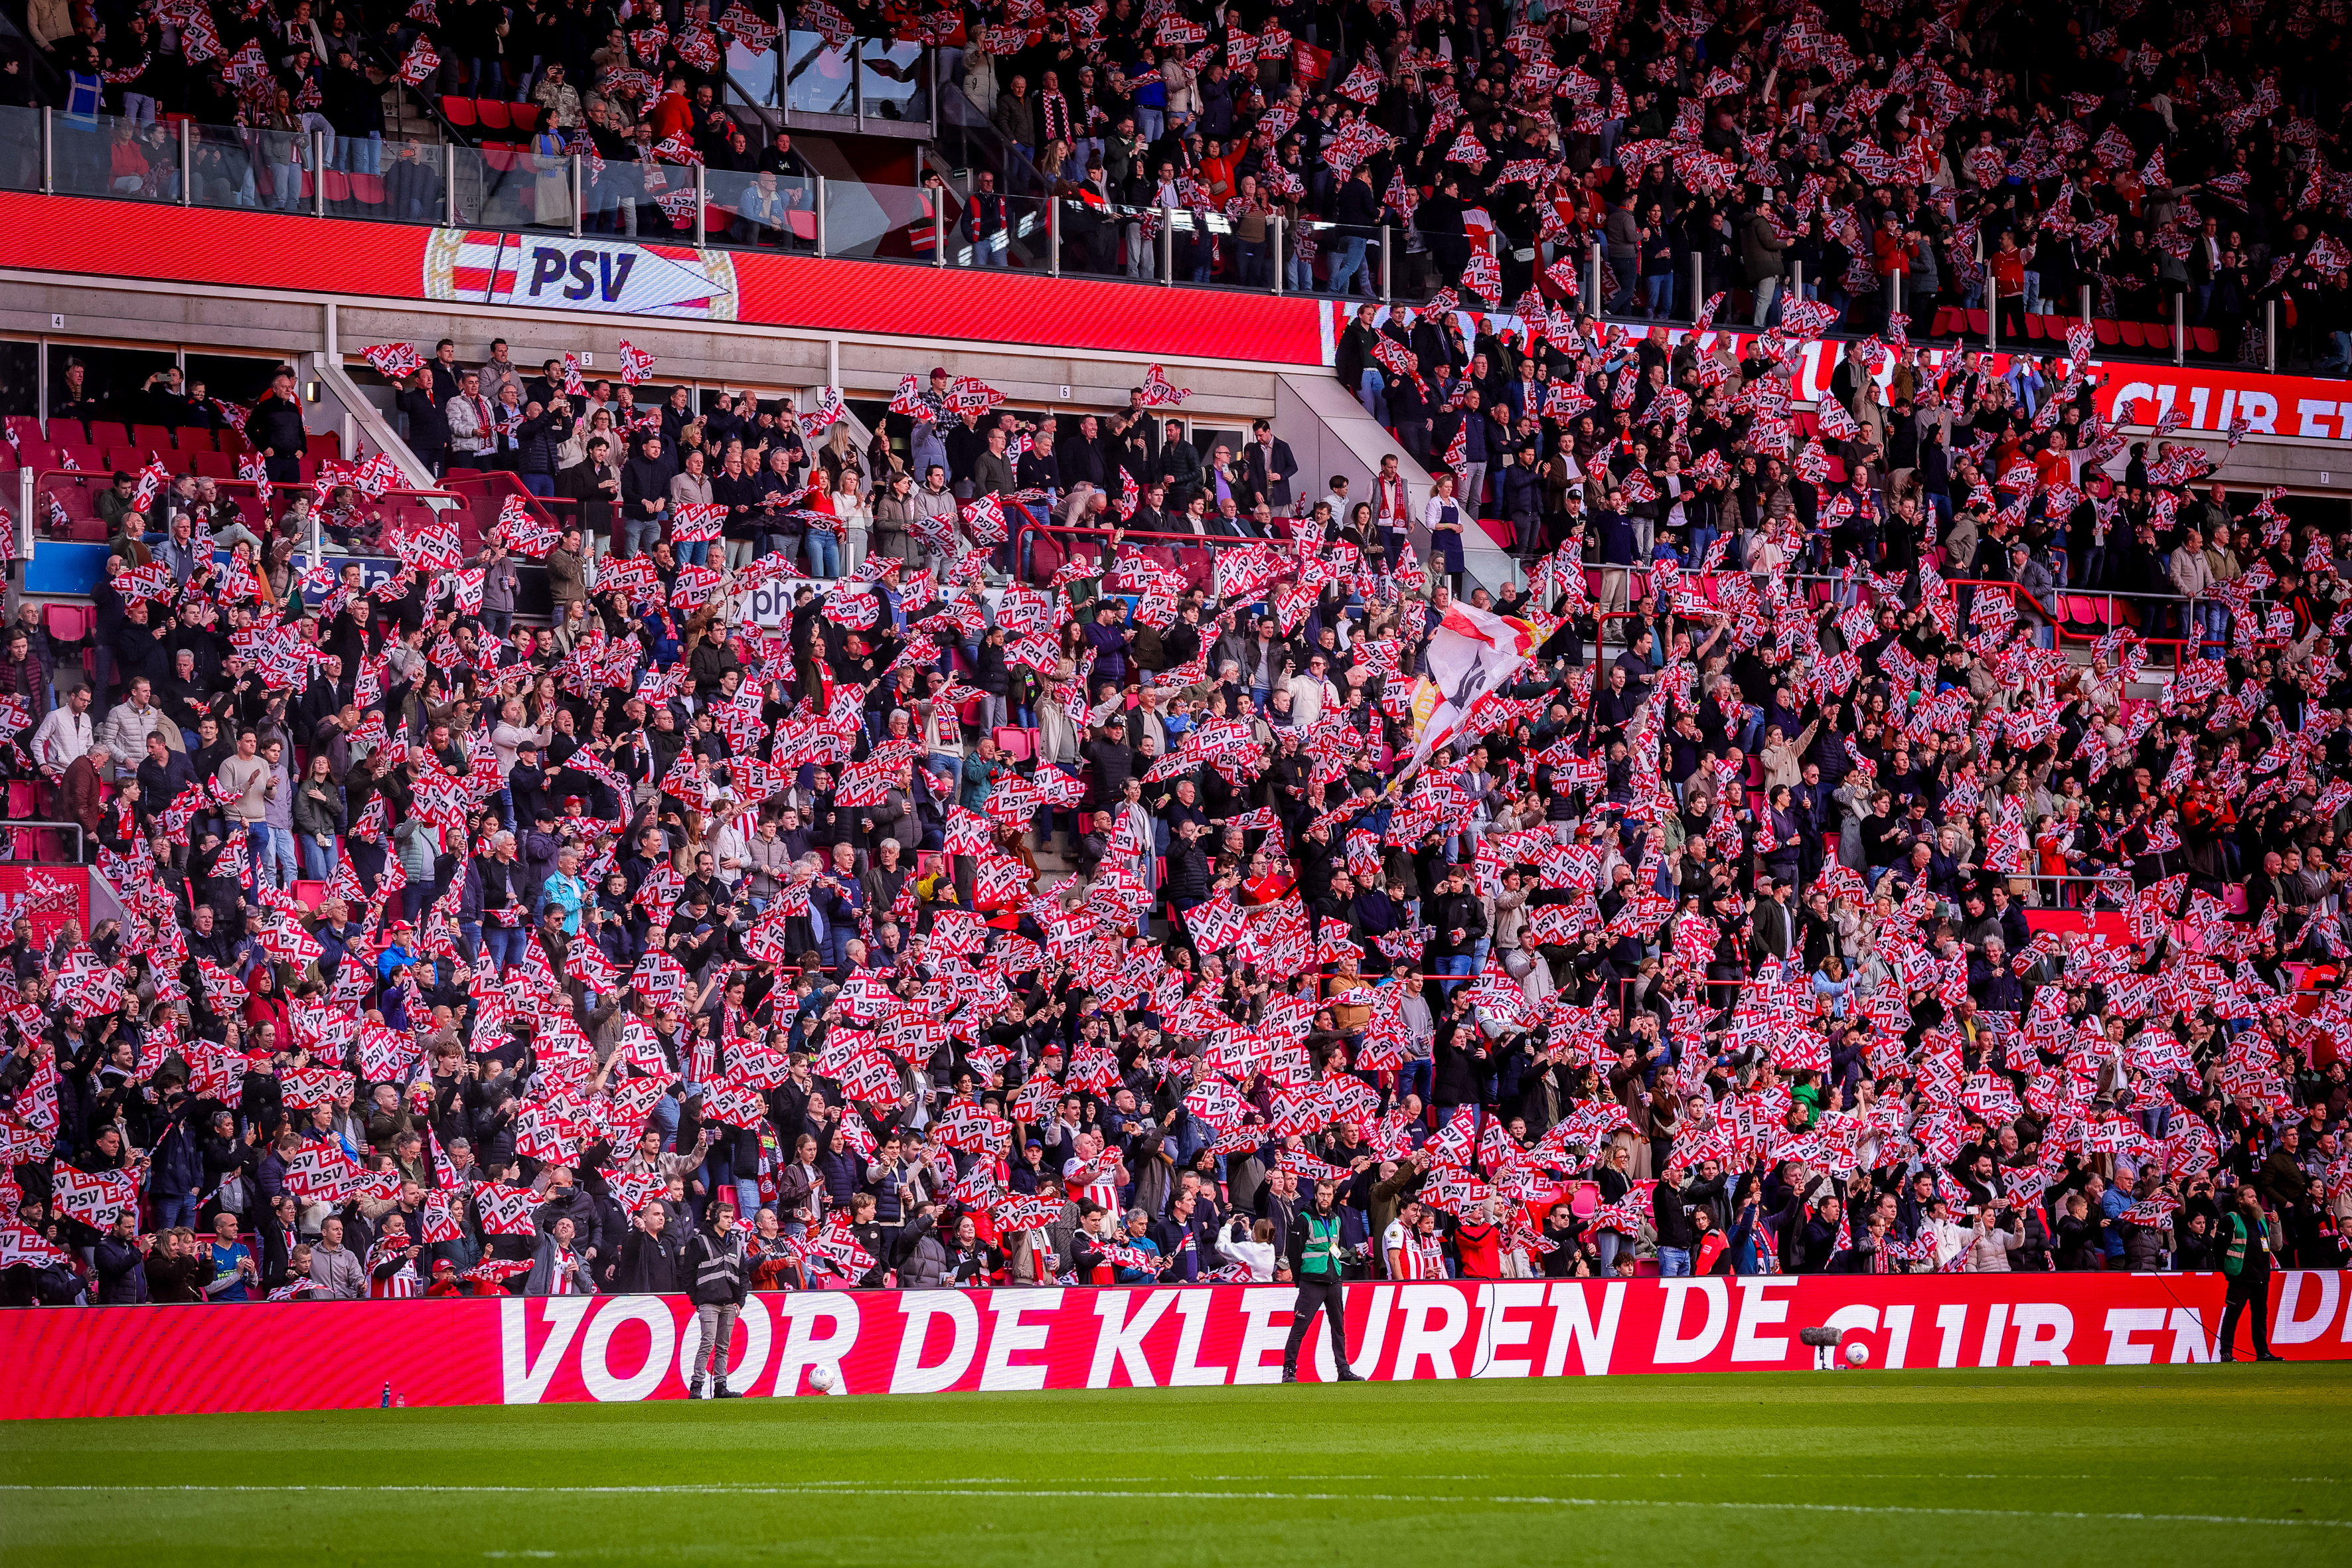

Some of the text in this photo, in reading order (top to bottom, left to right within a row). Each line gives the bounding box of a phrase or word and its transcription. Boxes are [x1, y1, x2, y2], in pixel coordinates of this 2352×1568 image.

[818, 16, 837, 27] PSV
[737, 23, 759, 34] PSV
[1521, 39, 1541, 48] PSV
[1800, 34, 1820, 46] PSV
[1714, 77, 1734, 89] PSV
[1458, 146, 1474, 157] PSV
[2102, 144, 2124, 154] PSV
[529, 246, 637, 301] PSV
[55, 316, 60, 325] 4
[1790, 309, 1806, 320] PSV
[585, 354, 589, 363] 5
[1697, 360, 1719, 374] PSV
[1063, 387, 1067, 396] 6
[960, 394, 984, 406] PSV
[1759, 396, 1781, 406] PSV
[1828, 412, 1847, 424] PSV
[2009, 471, 2029, 481] PSV
[686, 518, 706, 533] PSV
[975, 515, 996, 531] PSV
[613, 573, 637, 584] PSV
[1145, 597, 1164, 609] PSV
[1982, 599, 2003, 613] PSV
[838, 605, 858, 615] PSV
[1015, 605, 1037, 618] PSV
[736, 696, 759, 707] PSV
[834, 702, 850, 720] PSV
[813, 736, 834, 751] PSV
[1202, 730, 1225, 744] PSV
[785, 738, 803, 752] PSV
[882, 749, 903, 761] PSV
[852, 774, 878, 794] PSV
[1002, 795, 1028, 808] PSV
[1430, 789, 1449, 801] PSV
[993, 868, 1015, 886] PSV
[1206, 910, 1223, 933] PSV
[1536, 914, 1556, 929] PSV
[1125, 959, 1146, 979] PSV
[653, 973, 674, 986] PSV
[1097, 986, 1113, 999] PSV
[2120, 988, 2146, 1009] PSV
[1875, 1000, 1899, 1011] PSV
[1271, 1011, 1292, 1027] PSV
[897, 1028, 922, 1040] PSV
[2037, 1024, 2059, 1034] PSV
[1223, 1042, 1246, 1058] PSV
[1372, 1038, 1394, 1056] PSV
[2153, 1049, 2172, 1058] PSV
[364, 1046, 384, 1067] PSV
[1275, 1052, 1298, 1065] PSV
[862, 1065, 888, 1087] PSV
[2240, 1071, 2265, 1082] PSV
[303, 1077, 331, 1099] PSV
[636, 1085, 663, 1108] PSV
[1335, 1089, 1360, 1107] PSV
[1982, 1094, 2009, 1105] PSV
[1210, 1101, 1235, 1111] PSV
[1294, 1101, 1314, 1123] PSV
[960, 1121, 988, 1134] PSV
[2116, 1137, 2140, 1150] PSV
[311, 1165, 344, 1186] PSV
[1296, 1166, 1328, 1178] PSV
[2020, 1174, 2041, 1193] PSV
[1443, 1185, 1466, 1196] PSV
[67, 1190, 98, 1206] PSV
[501, 1194, 525, 1219] PSV
[1012, 1201, 1038, 1217] PSV
[500, 1289, 860, 1404] VOOR
[890, 1287, 1063, 1393] DE
[1086, 1281, 1625, 1389] KLEUREN
[1652, 1275, 1798, 1364] DE
